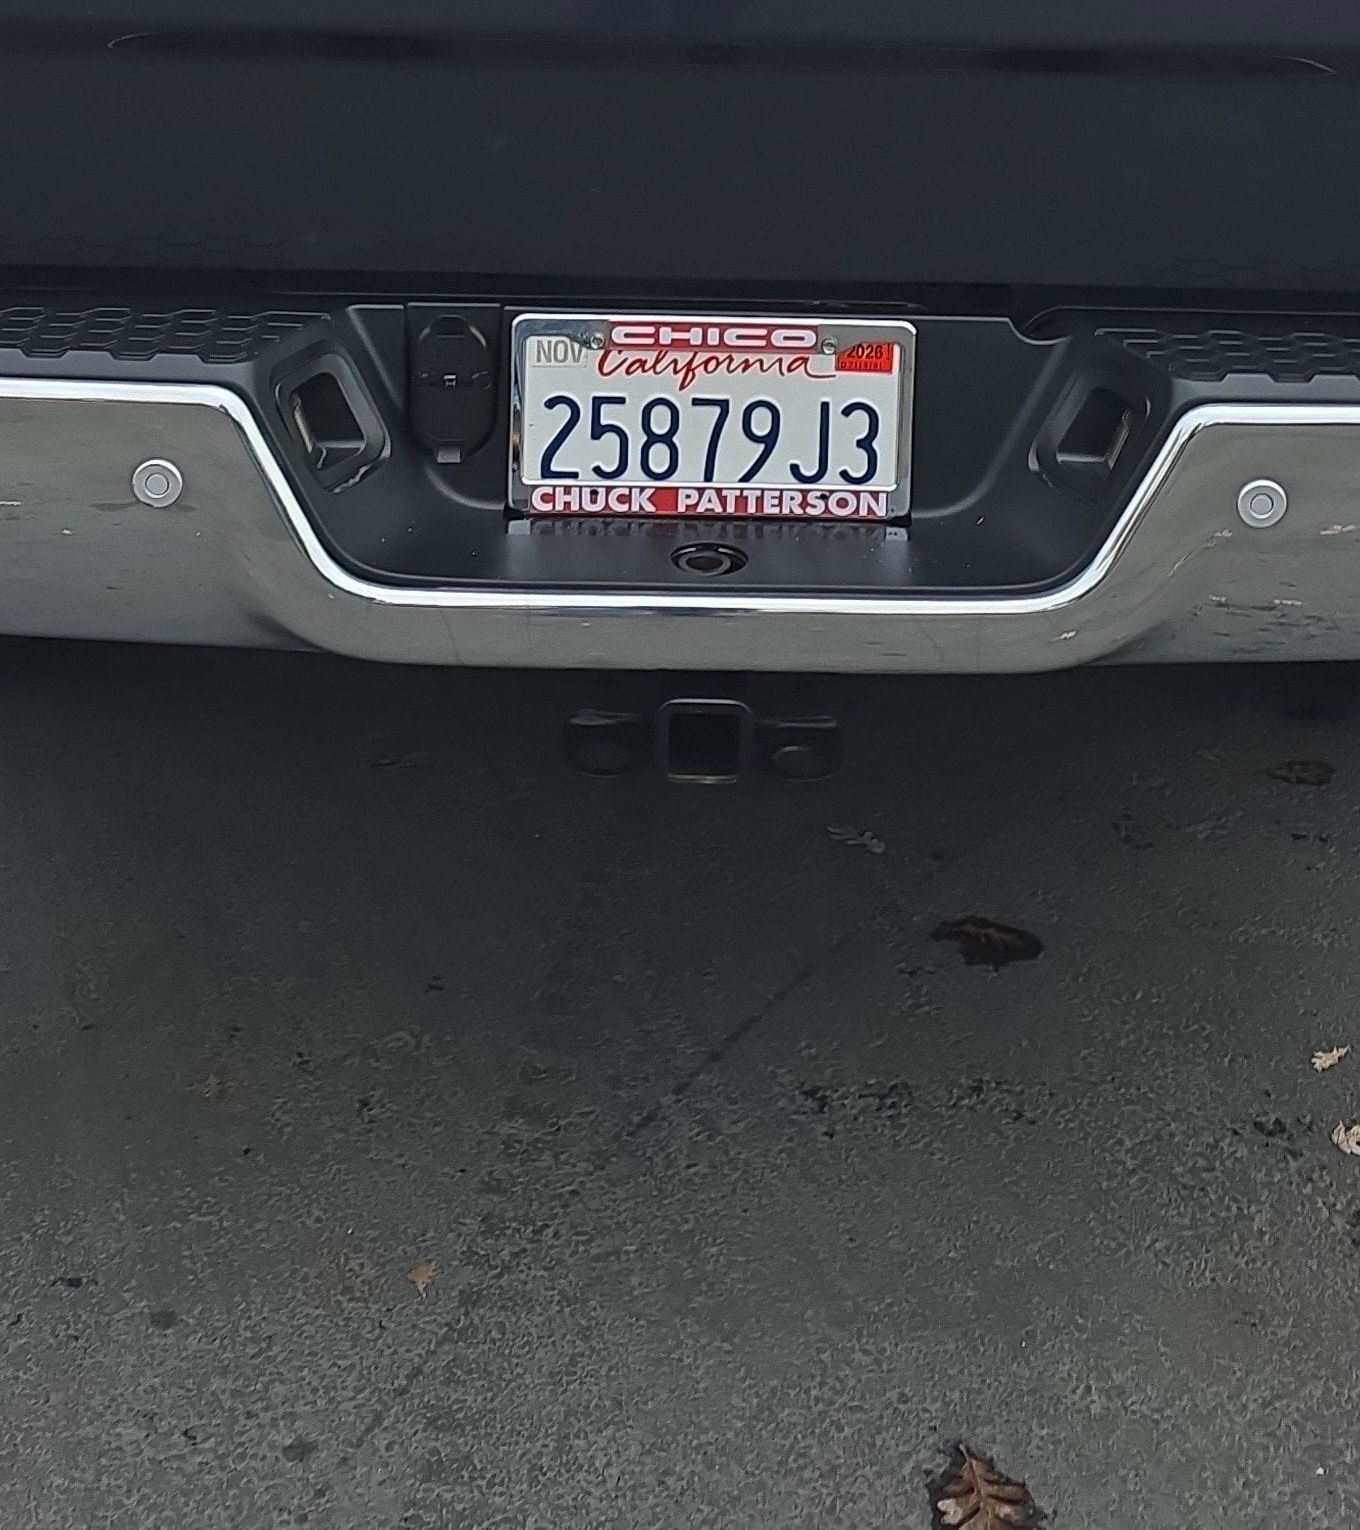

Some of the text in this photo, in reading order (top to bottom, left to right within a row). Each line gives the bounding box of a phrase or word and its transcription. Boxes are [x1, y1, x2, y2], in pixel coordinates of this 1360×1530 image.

[610, 325, 817, 348] CHICO
[536, 339, 583, 363] NOV
[846, 343, 883, 360] 2026
[597, 350, 836, 390] California
[540, 395, 880, 485] 25879J3
[531, 487, 888, 516] CHUCK PATTERSON
